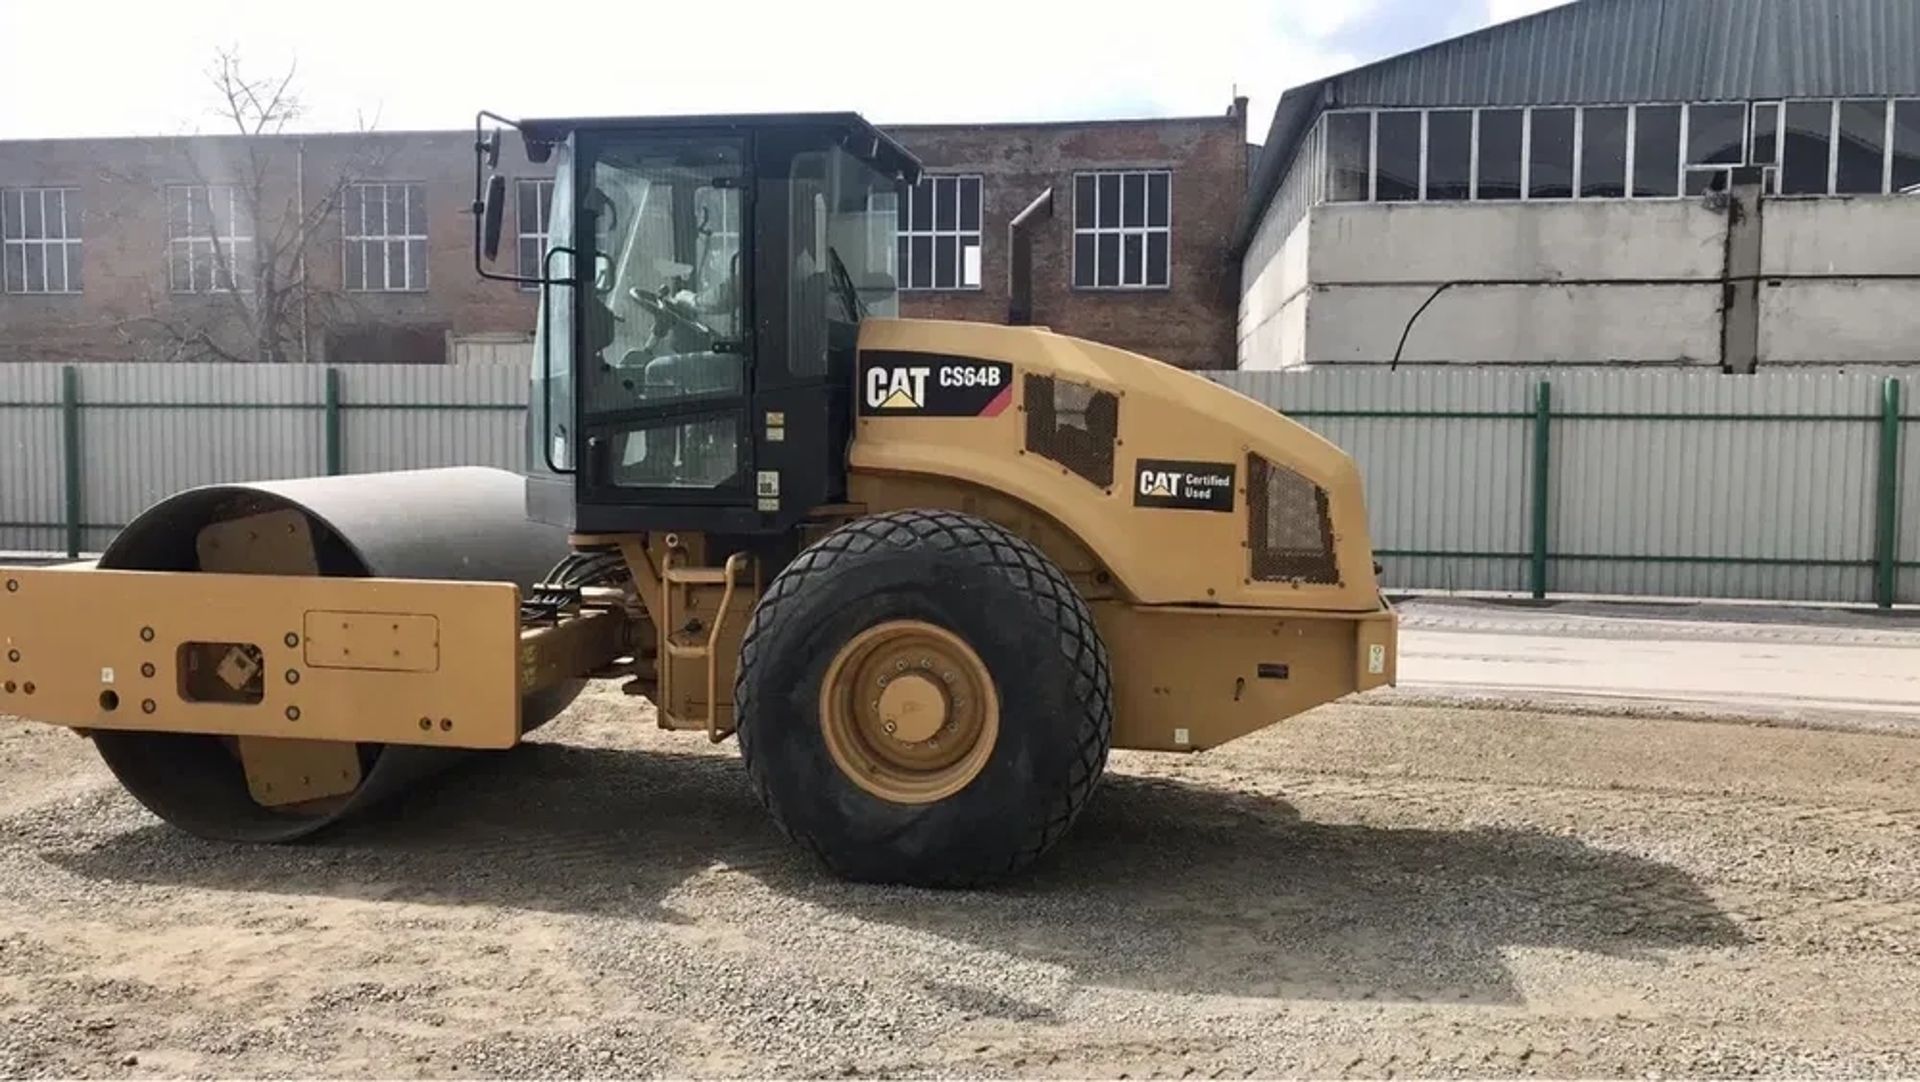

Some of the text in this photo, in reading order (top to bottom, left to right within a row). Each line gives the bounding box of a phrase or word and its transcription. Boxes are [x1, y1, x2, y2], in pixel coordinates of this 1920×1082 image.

[866, 366, 1000, 408] CAT CS64B
[1140, 471, 1181, 496] CAT
[1185, 473, 1230, 487] Certified
[1185, 486, 1212, 499] Used
